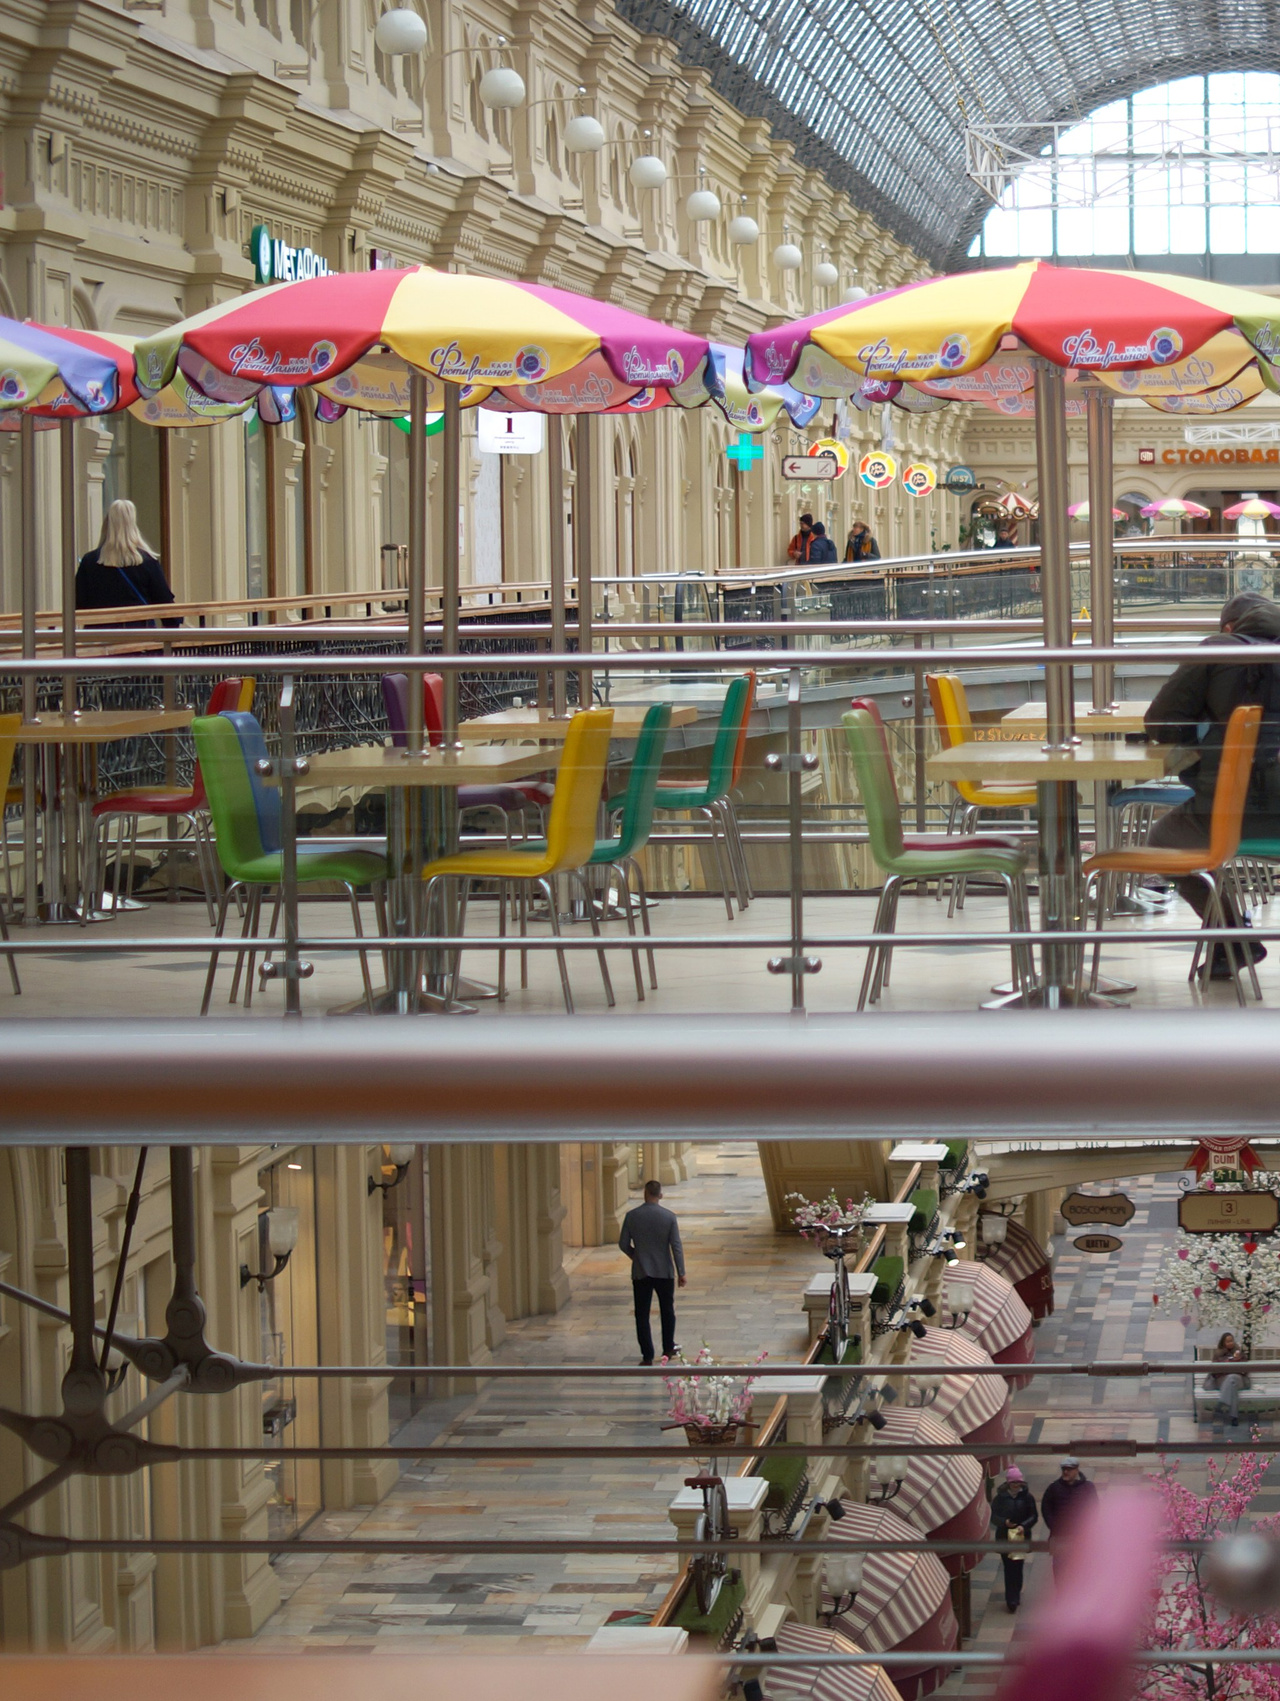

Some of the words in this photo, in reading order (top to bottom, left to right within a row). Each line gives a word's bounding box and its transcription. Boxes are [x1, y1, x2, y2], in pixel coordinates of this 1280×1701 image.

[1161, 449, 1280, 464] СТОЛОВАЯ
[1213, 1154, 1235, 1165] GUM
[1226, 1203, 1234, 1213] 3
